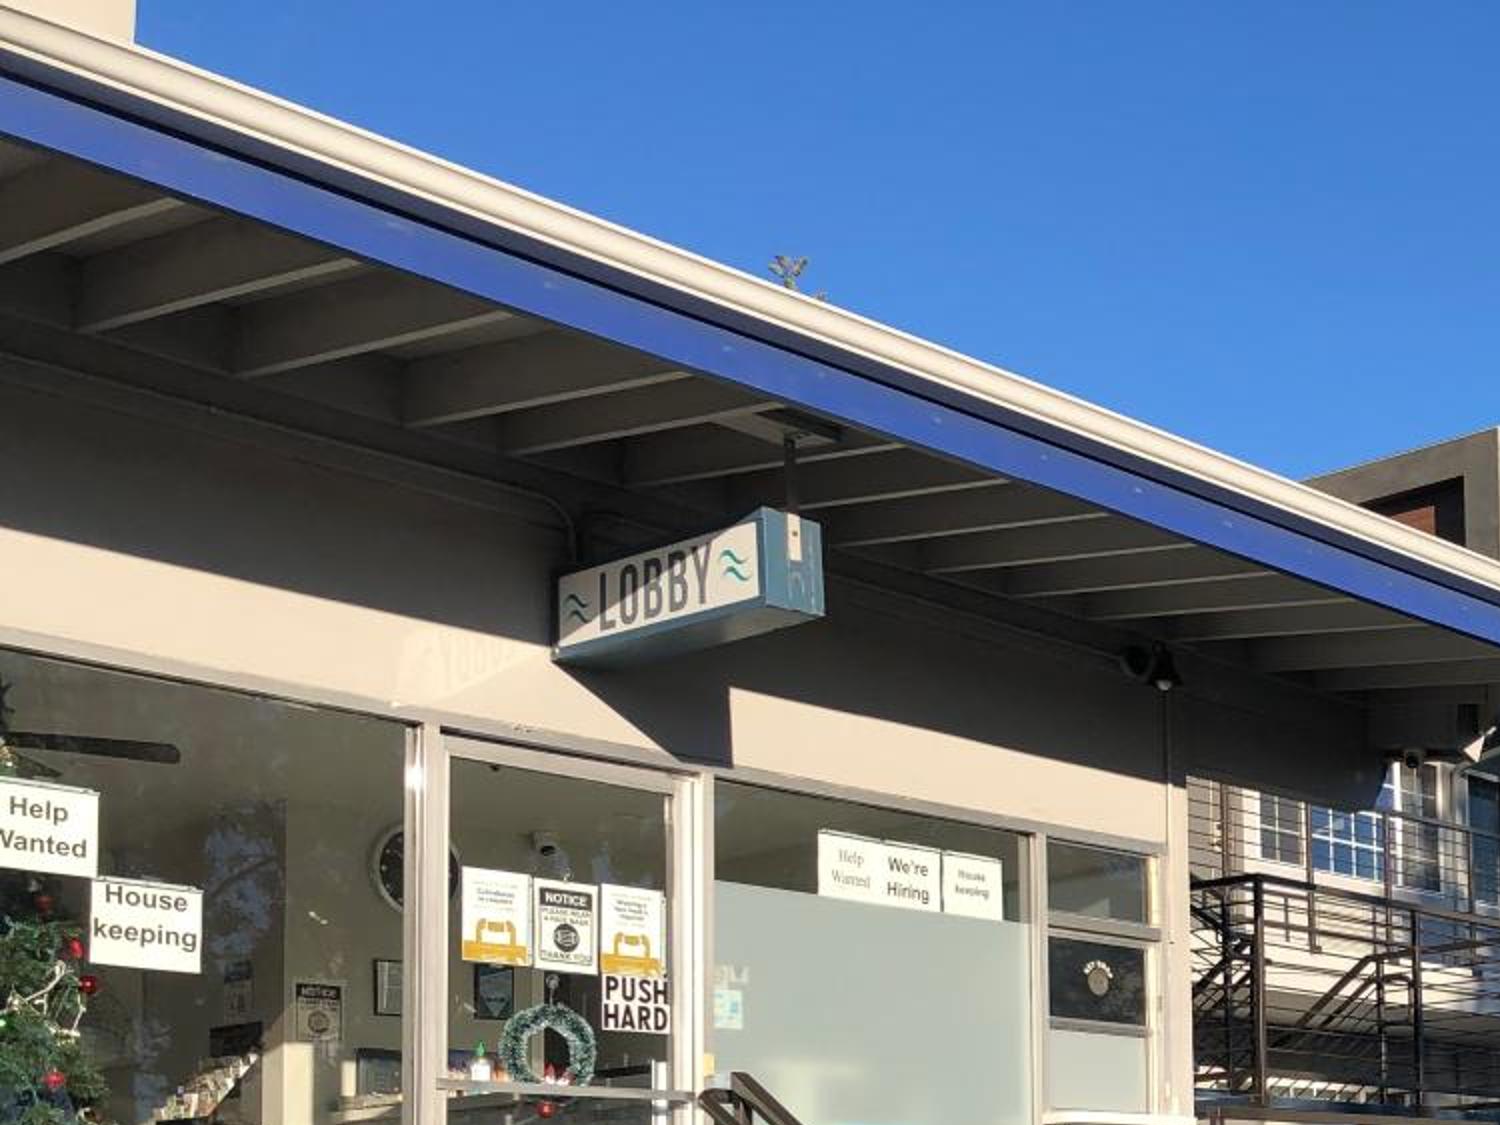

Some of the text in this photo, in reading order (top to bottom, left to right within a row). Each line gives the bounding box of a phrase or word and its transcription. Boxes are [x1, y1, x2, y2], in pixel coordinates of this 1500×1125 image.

[600, 541, 712, 630] LOBBY
[9, 795, 69, 826] Help
[838, 849, 865, 867] Help
[888, 856, 928, 876] We're
[831, 869, 871, 889] Wanted
[887, 881, 929, 904] Hiring
[105, 883, 188, 912] House
[545, 892, 587, 907] NOTICE
[93, 917, 197, 953] keeping
[605, 975, 668, 1005] PUSH
[603, 1003, 668, 1032] HARD
